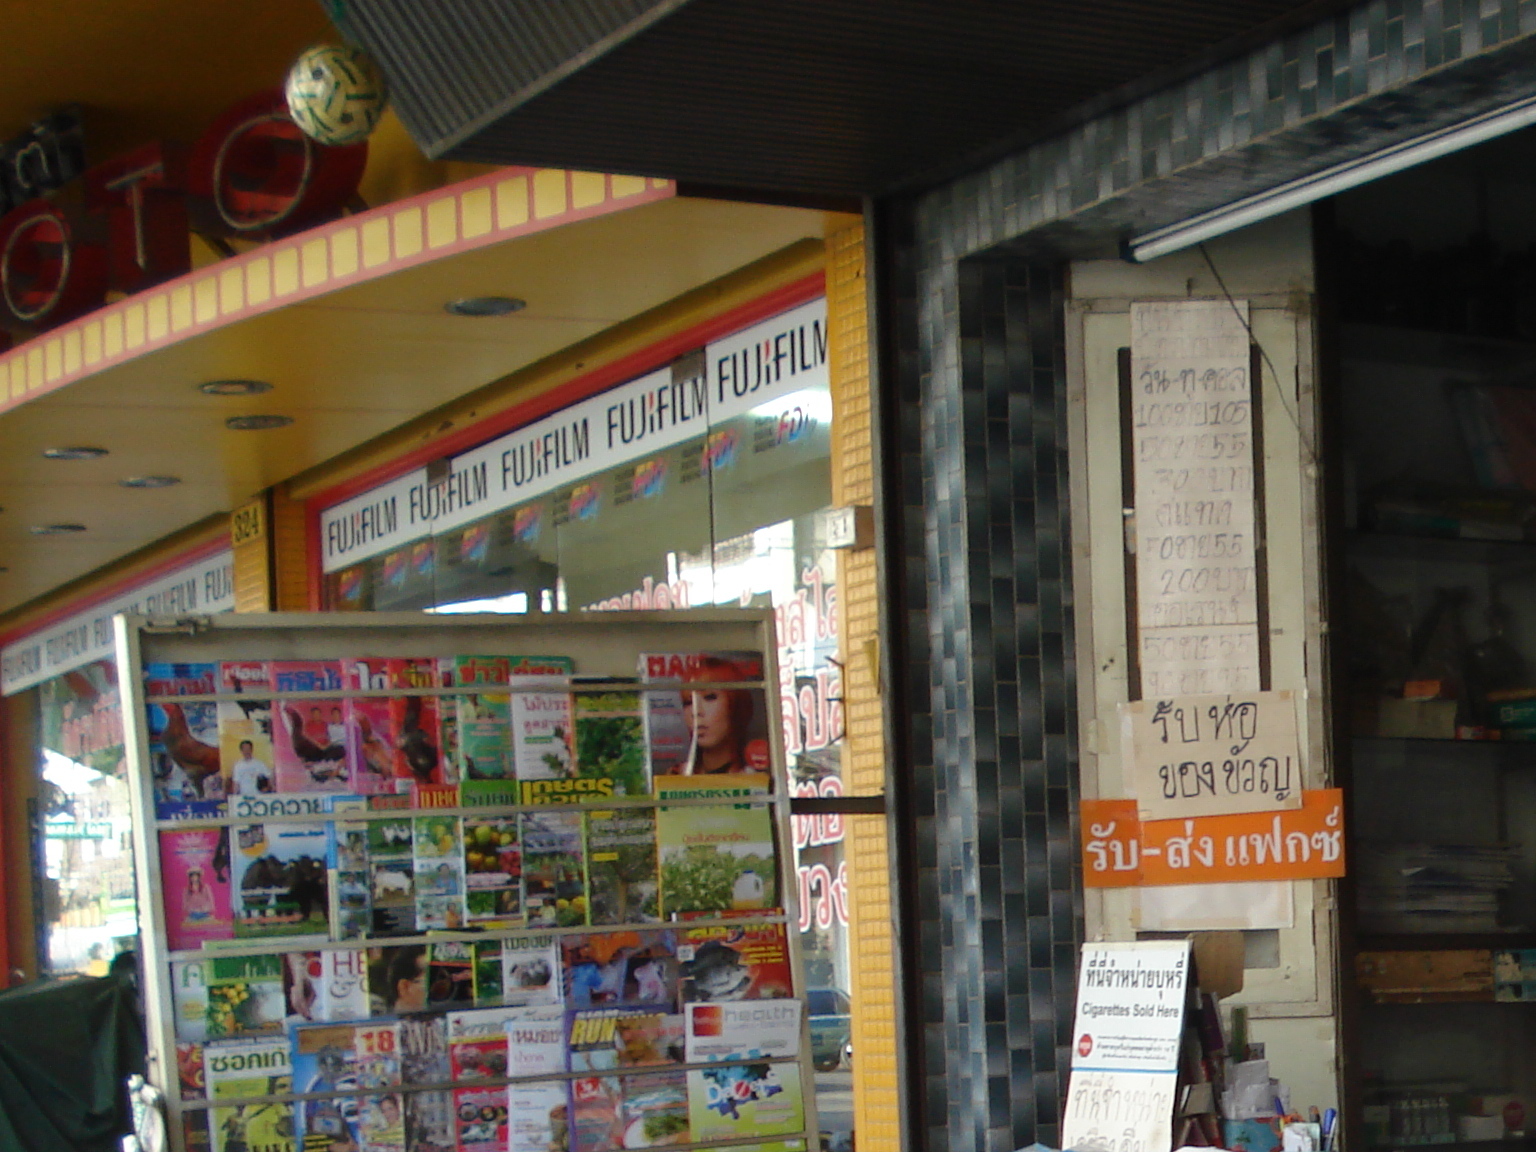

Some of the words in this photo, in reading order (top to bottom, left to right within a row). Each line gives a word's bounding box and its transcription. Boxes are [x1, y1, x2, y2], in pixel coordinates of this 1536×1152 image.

[607, 378, 708, 449] FUJIFILM
[503, 417, 589, 491] FUJIFILM
[234, 505, 260, 544] 324
[409, 462, 487, 526] FUJIFILM
[329, 497, 397, 556] FUJIFILM
[1152, 700, 1199, 743] รับ
[1208, 694, 1258, 741] ห่อ
[1086, 819, 1215, 872] รับ-ส่ง
[1225, 806, 1343, 867] แฟกซ์
[1081, 1001, 1131, 1018] Cigarettes
[1132, 1002, 1156, 1018] Sold
[1156, 1002, 1180, 1019] Here
